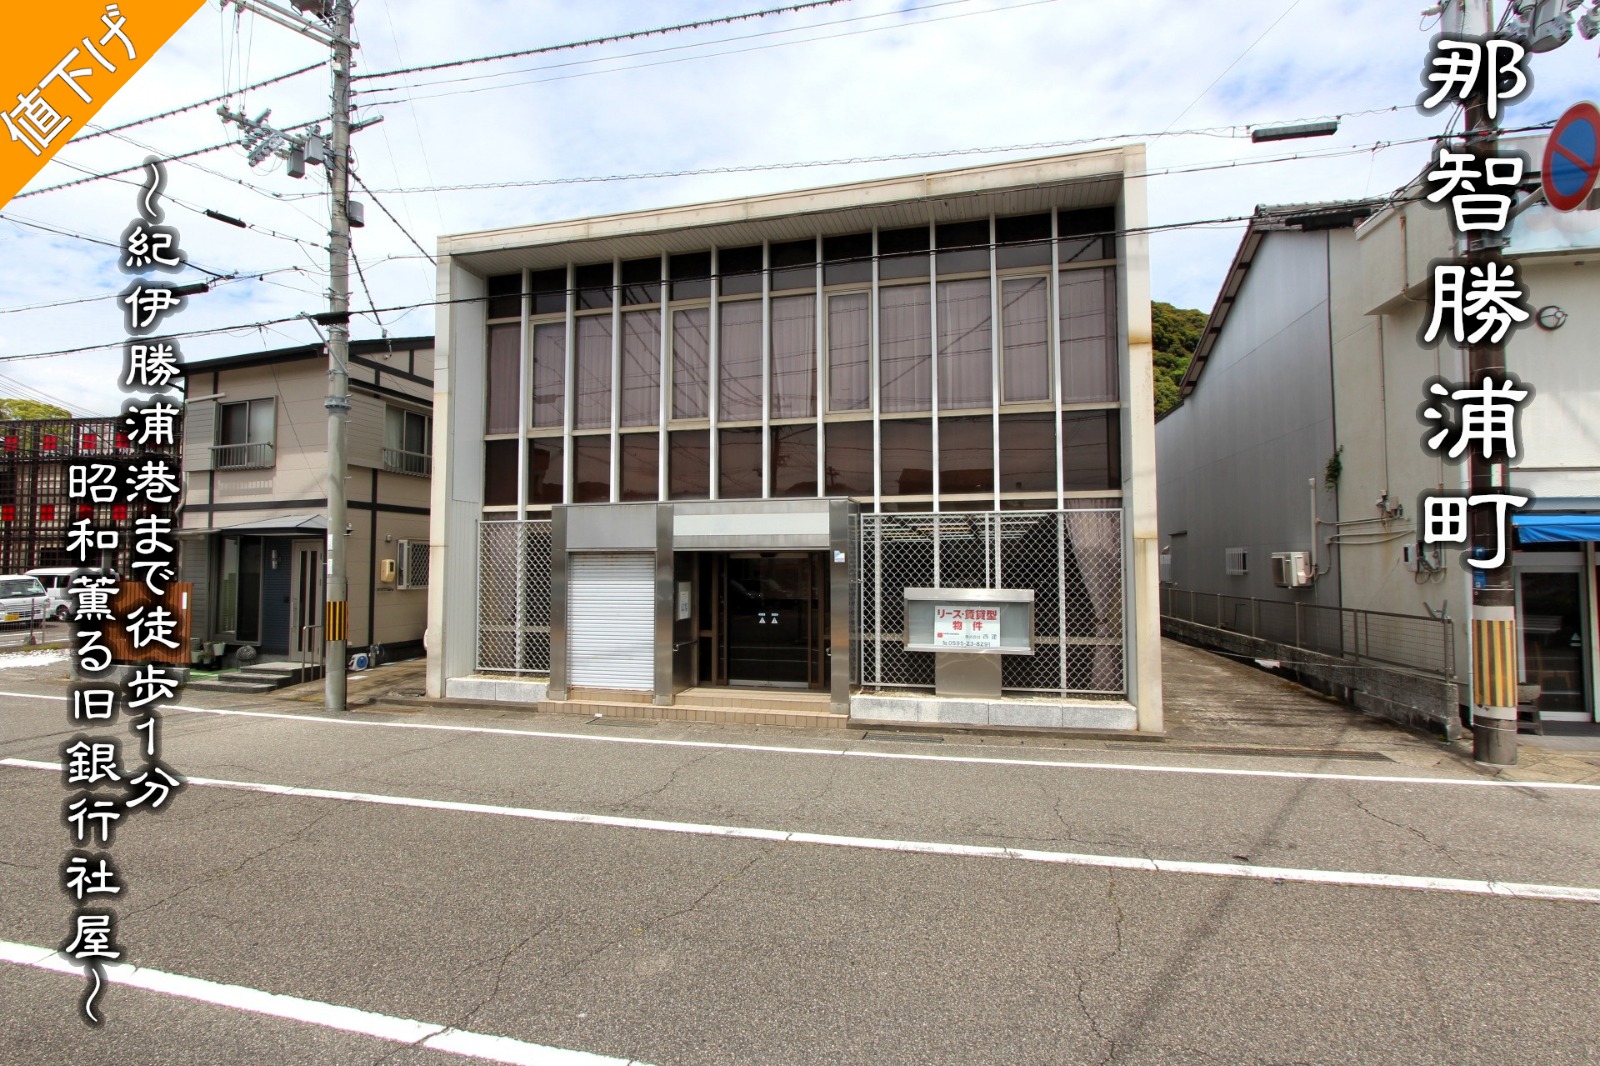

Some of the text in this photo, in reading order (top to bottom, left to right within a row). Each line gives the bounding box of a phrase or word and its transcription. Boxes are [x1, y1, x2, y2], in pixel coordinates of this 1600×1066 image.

[937, 609, 997, 620] リース・賃貸型
